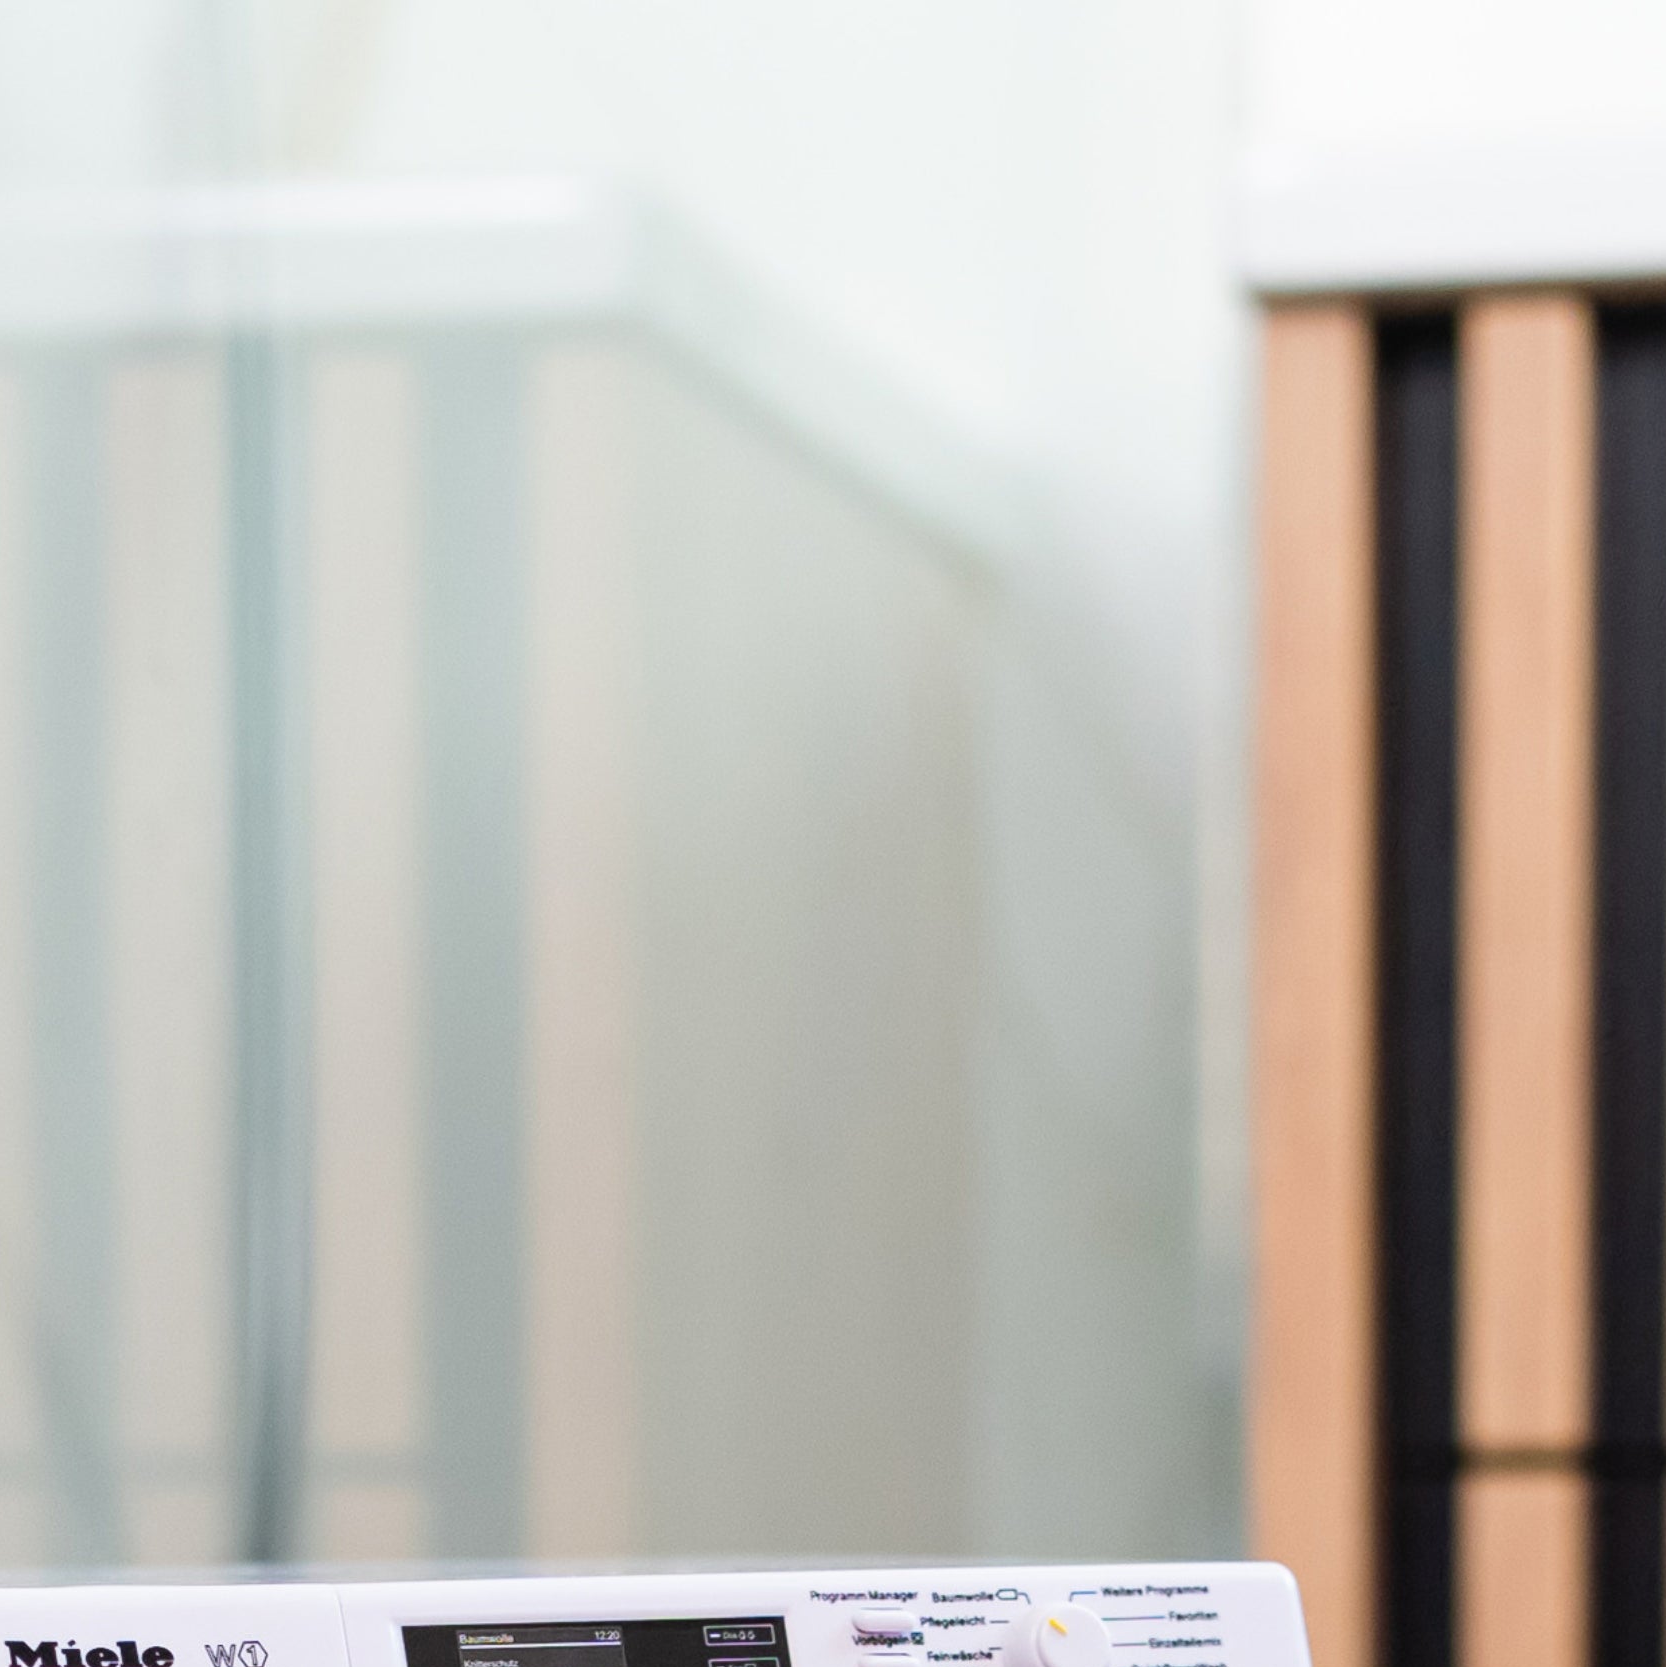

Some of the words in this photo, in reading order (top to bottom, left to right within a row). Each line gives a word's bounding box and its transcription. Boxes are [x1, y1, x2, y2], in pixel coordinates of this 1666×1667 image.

[810, 1590, 867, 1603] Programm
[868, 1590, 918, 1603] Manager
[1101, 1587, 1143, 1596] Weitere
[1145, 1585, 1208, 1597] Programme
[932, 1592, 994, 1603] Baumwolle
[1168, 1611, 1218, 1621] Favoriten
[920, 1616, 985, 1630] Pflegeleicht
[459, 1633, 514, 1644] Baumwolle
